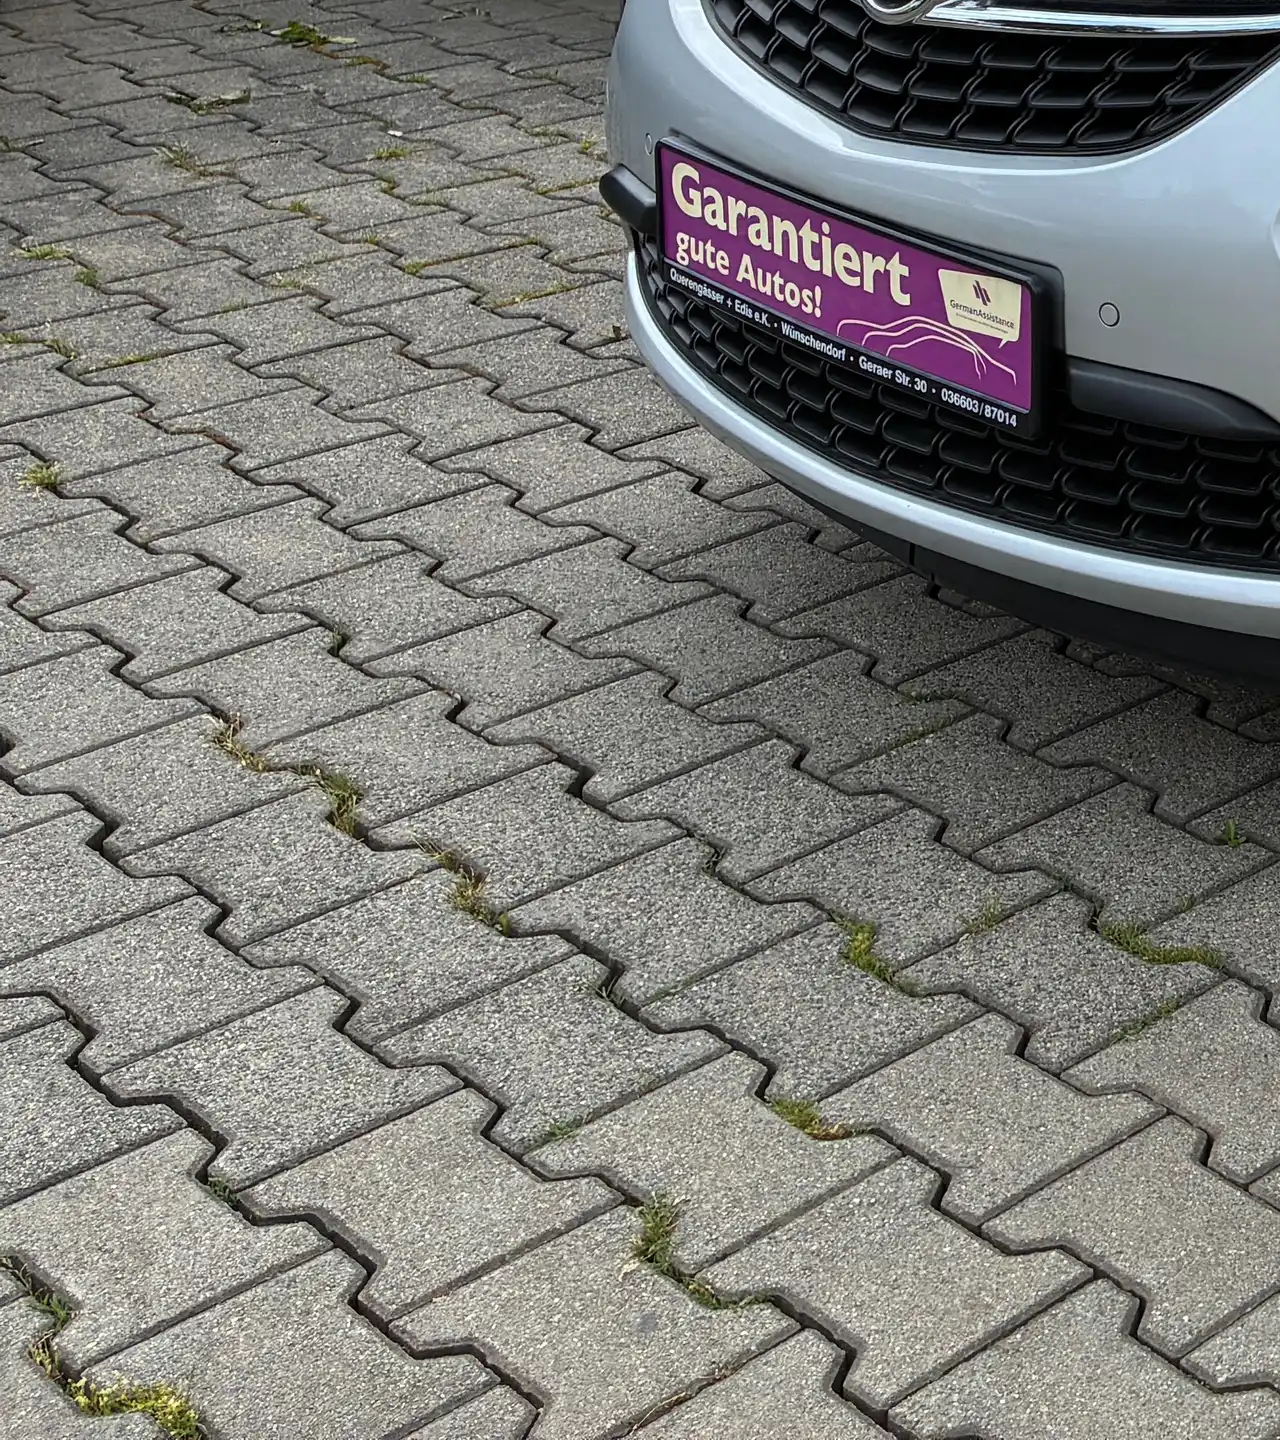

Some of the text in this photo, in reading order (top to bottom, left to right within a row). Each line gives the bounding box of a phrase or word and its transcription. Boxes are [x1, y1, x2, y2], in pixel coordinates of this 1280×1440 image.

[672, 162, 911, 306] Garantiert
[676, 231, 822, 318] gute Autos!
[734, 301, 753, 319] Edis
[754, 312, 771, 328] e.K.
[781, 321, 846, 361] Wünschendorf
[858, 355, 893, 380] Geraer
[895, 369, 912, 388] Str.
[914, 378, 927, 393] 30
[949, 299, 1015, 329] GermanAssistance
